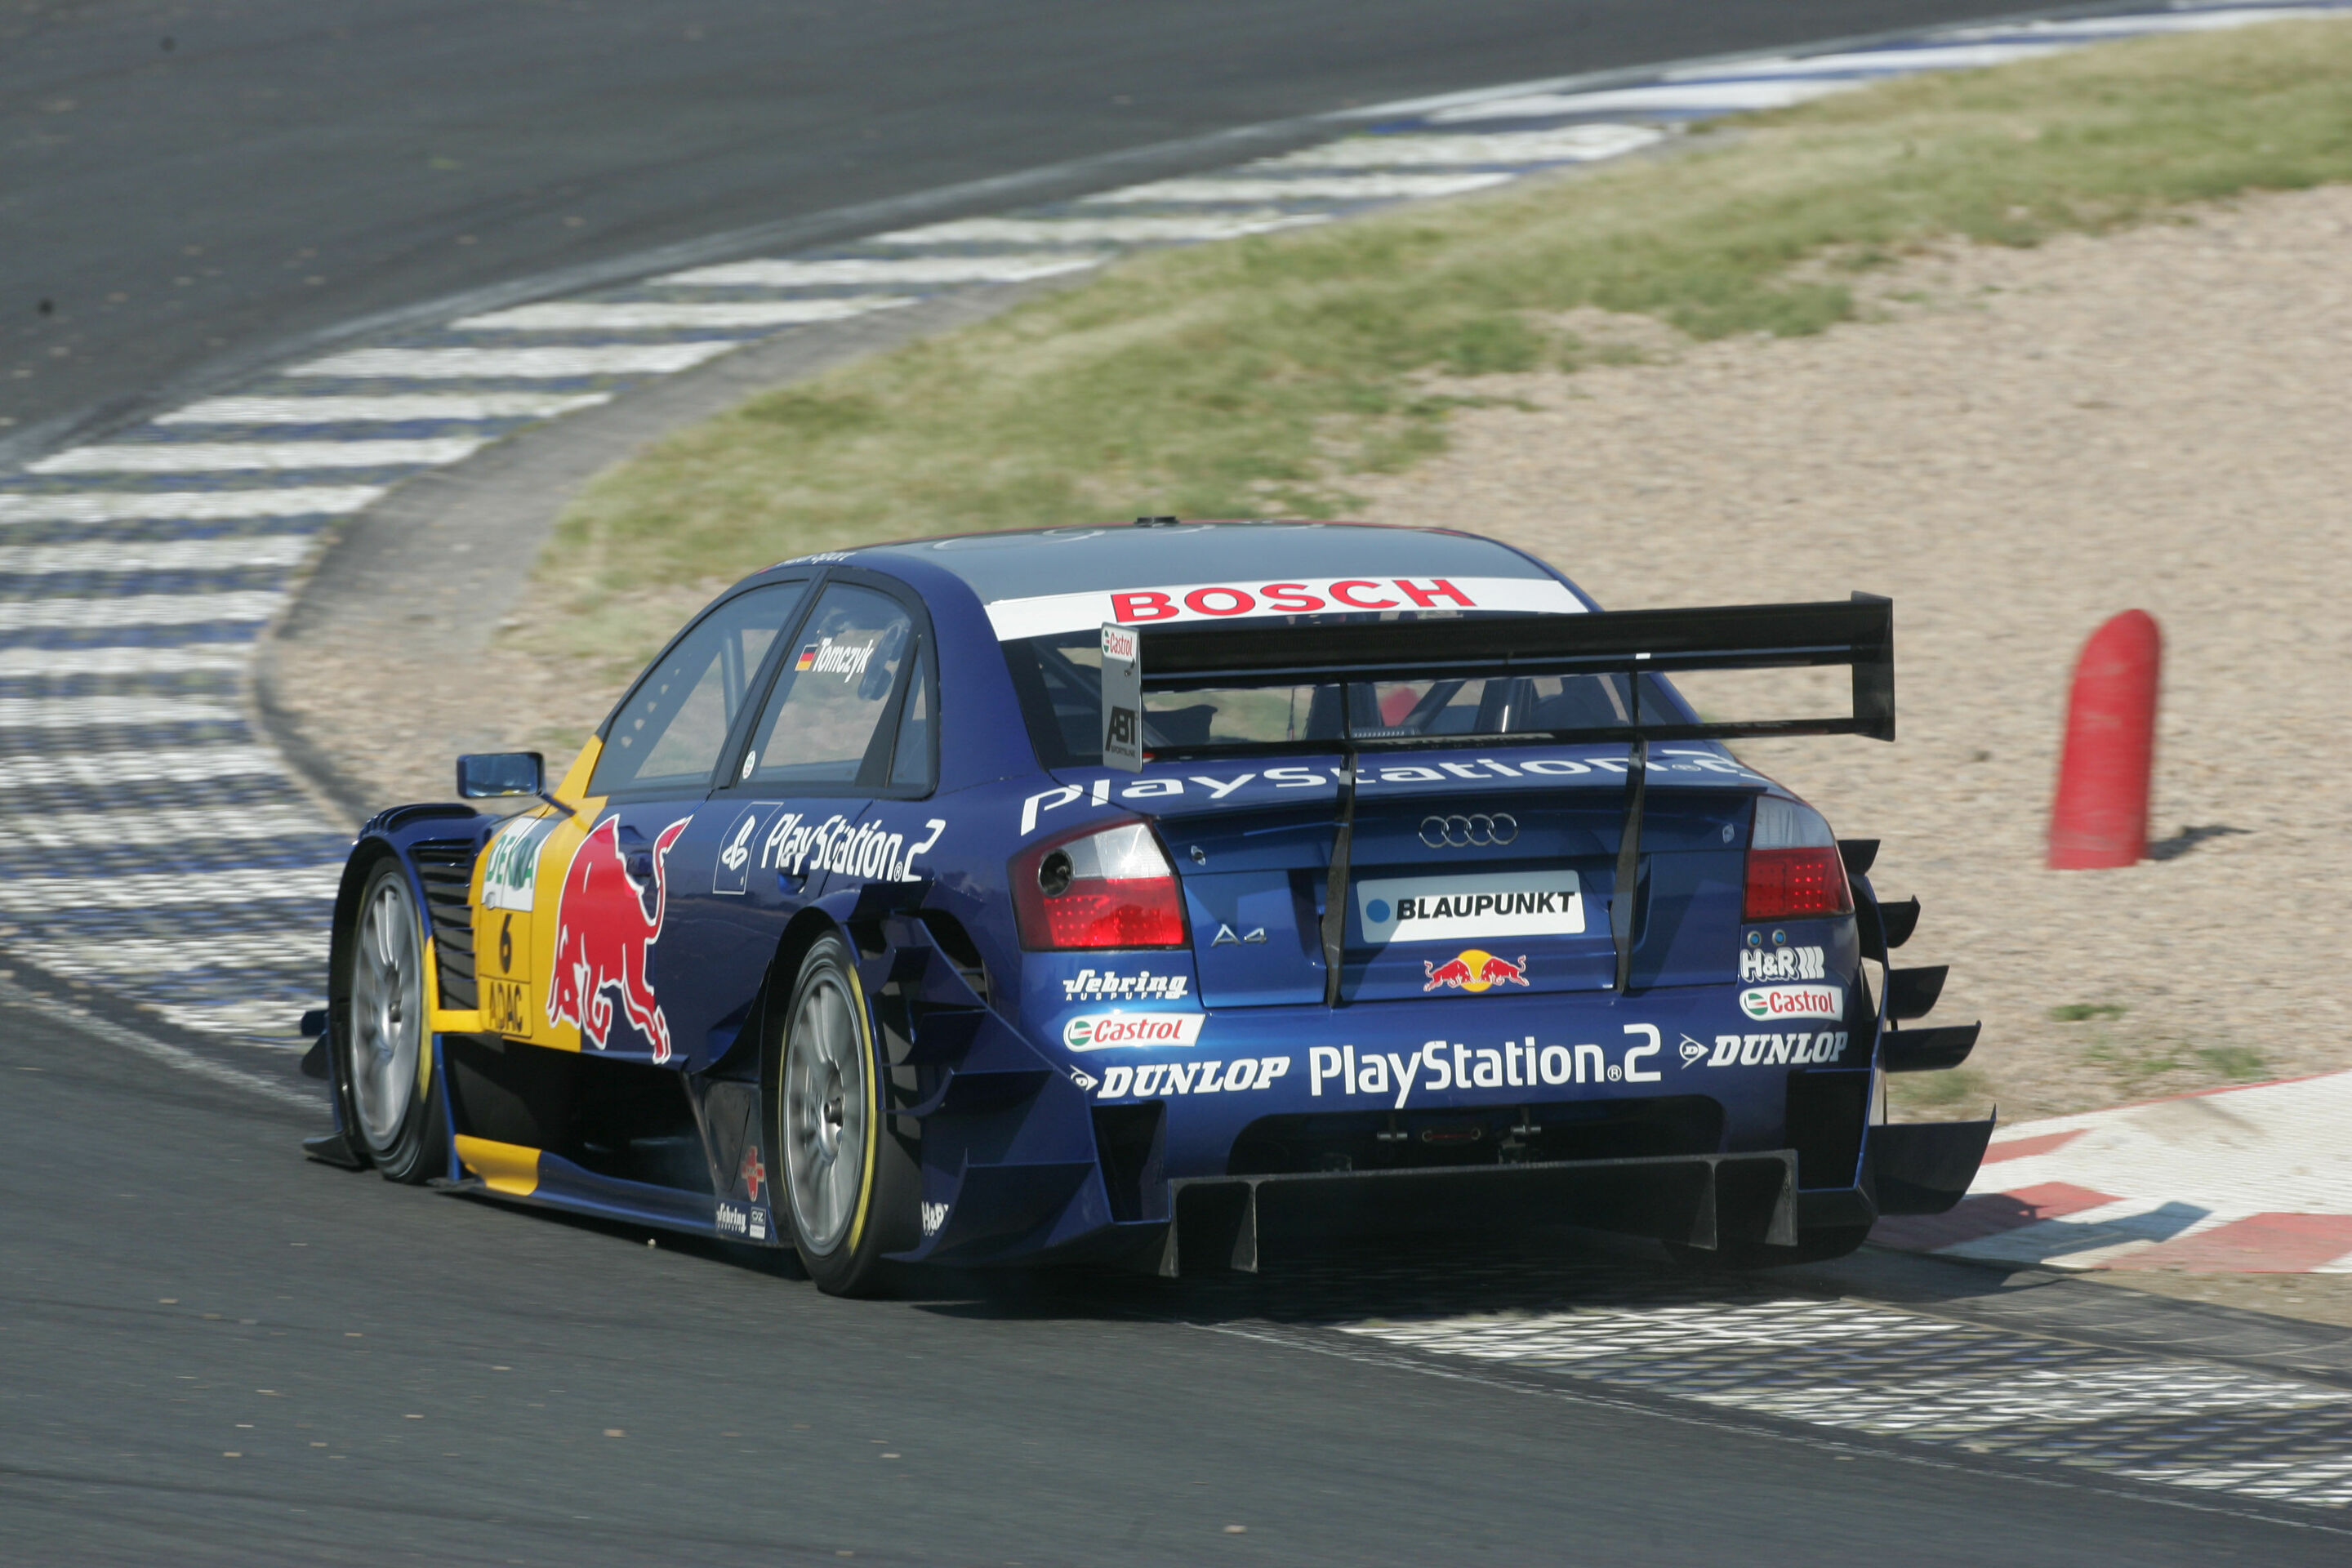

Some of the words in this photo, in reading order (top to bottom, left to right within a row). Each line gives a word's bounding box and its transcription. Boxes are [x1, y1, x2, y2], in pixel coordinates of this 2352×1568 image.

[1111, 579, 1477, 623] BOSCH
[813, 637, 874, 683] Tomczyk
[1110, 633, 1133, 656] Castrol
[1105, 706, 1136, 751] ABT
[1396, 891, 1575, 920] BLAUPUNKT
[500, 913, 513, 974] 6
[1211, 924, 1267, 947] A4
[1740, 947, 1800, 982] H&R
[1063, 969, 1187, 1000] Sebring
[1066, 992, 1163, 1001] AUSPUFF
[1770, 991, 1835, 1013] Castrol
[489, 982, 523, 1033] ADAC
[1094, 1018, 1183, 1043] Castrol
[1707, 1031, 1848, 1067] DUNLOP
[1097, 1056, 1290, 1098] DUNLOP
